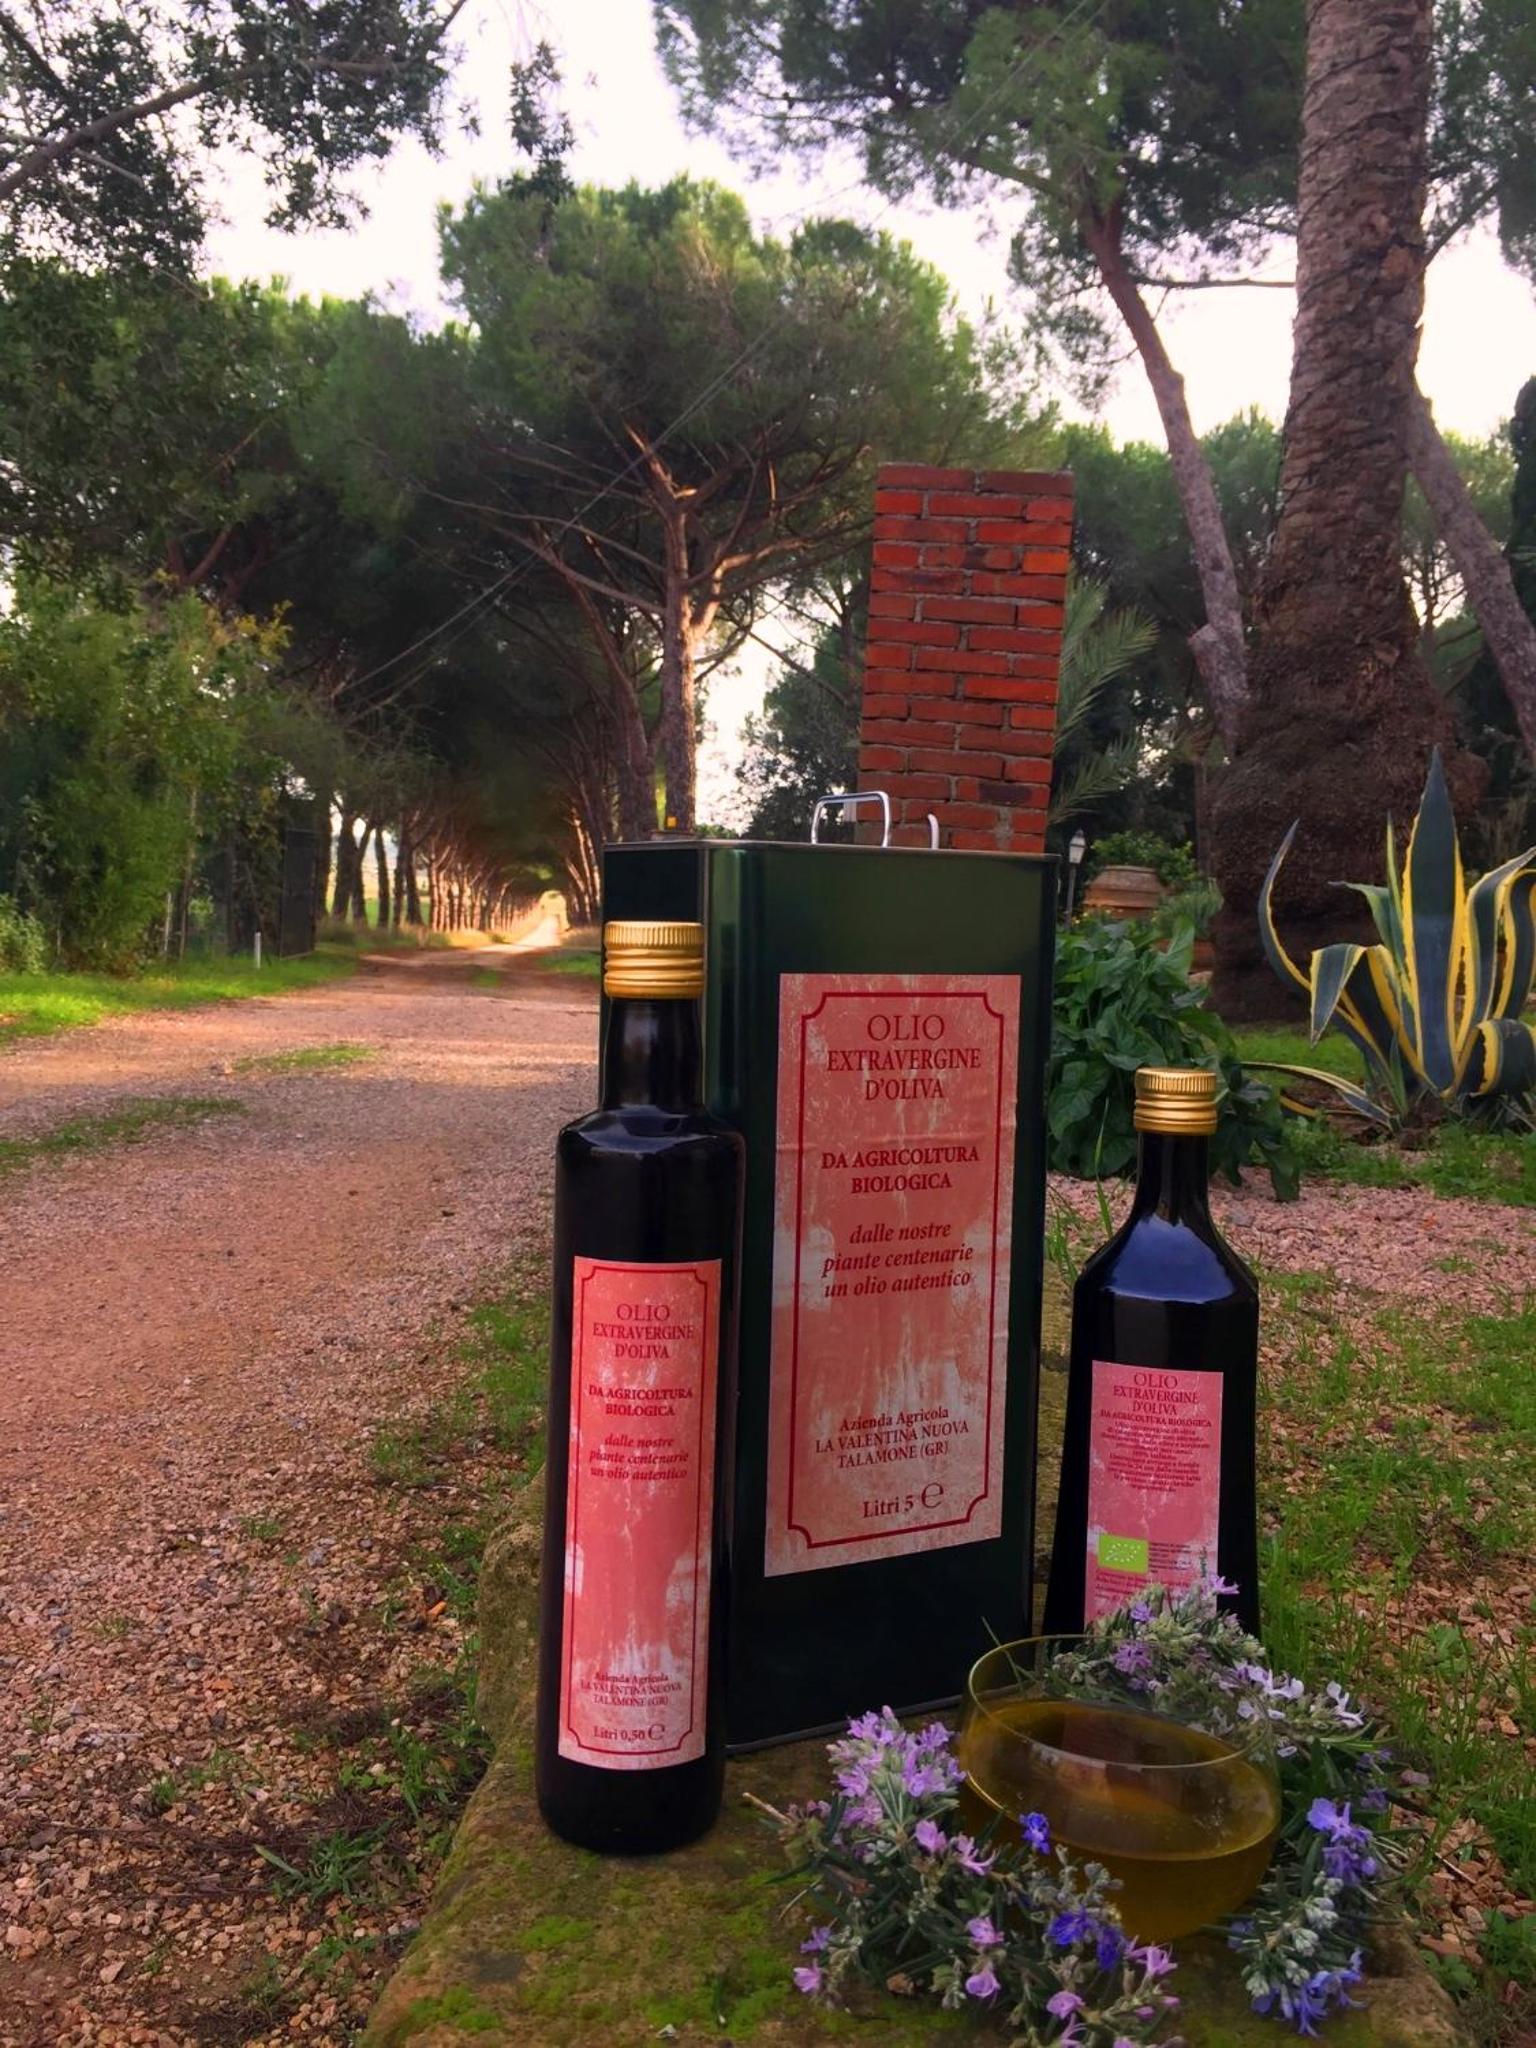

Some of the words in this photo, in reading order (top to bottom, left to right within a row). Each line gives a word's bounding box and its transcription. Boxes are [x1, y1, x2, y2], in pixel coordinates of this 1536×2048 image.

[867, 1014, 946, 1041] OLIO
[826, 1048, 982, 1072] EXTRAVERGINE
[865, 1078, 945, 1101] D'OLIVA
[821, 1152, 848, 1169] DA
[852, 1146, 980, 1169] AGRICOLTURA
[851, 1172, 952, 1194] BIOLOGICA
[850, 1223, 894, 1245] dalle
[899, 1224, 951, 1242] nostre
[822, 1252, 881, 1279] piante
[884, 1244, 974, 1268] centenarie
[824, 1282, 848, 1299] un
[854, 1276, 889, 1297] olio
[891, 1270, 972, 1293] autentico
[616, 1304, 670, 1321] OLIO
[592, 1322, 694, 1340] EXTRAVERGINE
[615, 1344, 670, 1359] D'OLIVA
[1134, 1372, 1178, 1388] OLIO
[588, 1384, 604, 1397] DA
[608, 1388, 693, 1401] AGRICOLTURA
[1114, 1385, 1199, 1403] EXTRAVERGINE
[606, 1404, 675, 1417] BIOLOGICA
[1133, 1401, 1177, 1415] D'OLIVA
[840, 1413, 893, 1432] Azienda
[896, 1406, 949, 1427] Agricola
[1112, 1412, 1166, 1425] AGRICOLTURA
[604, 1434, 635, 1447] dalle
[637, 1436, 674, 1449] nostre
[816, 1439, 834, 1454] LA
[838, 1430, 918, 1450] VALENTINA
[920, 1420, 969, 1438] NUOVA
[589, 1450, 624, 1463] piante
[628, 1452, 689, 1465] centenarie
[837, 1446, 918, 1469] TALAMONE
[920, 1441, 950, 1460] (GR)
[606, 1466, 629, 1479] olio
[632, 1468, 687, 1480] autentico
[863, 1496, 900, 1518] Litri
[904, 1494, 913, 1512] 5
[594, 1726, 617, 1740] Litri
[621, 1729, 645, 1741] 0,50
